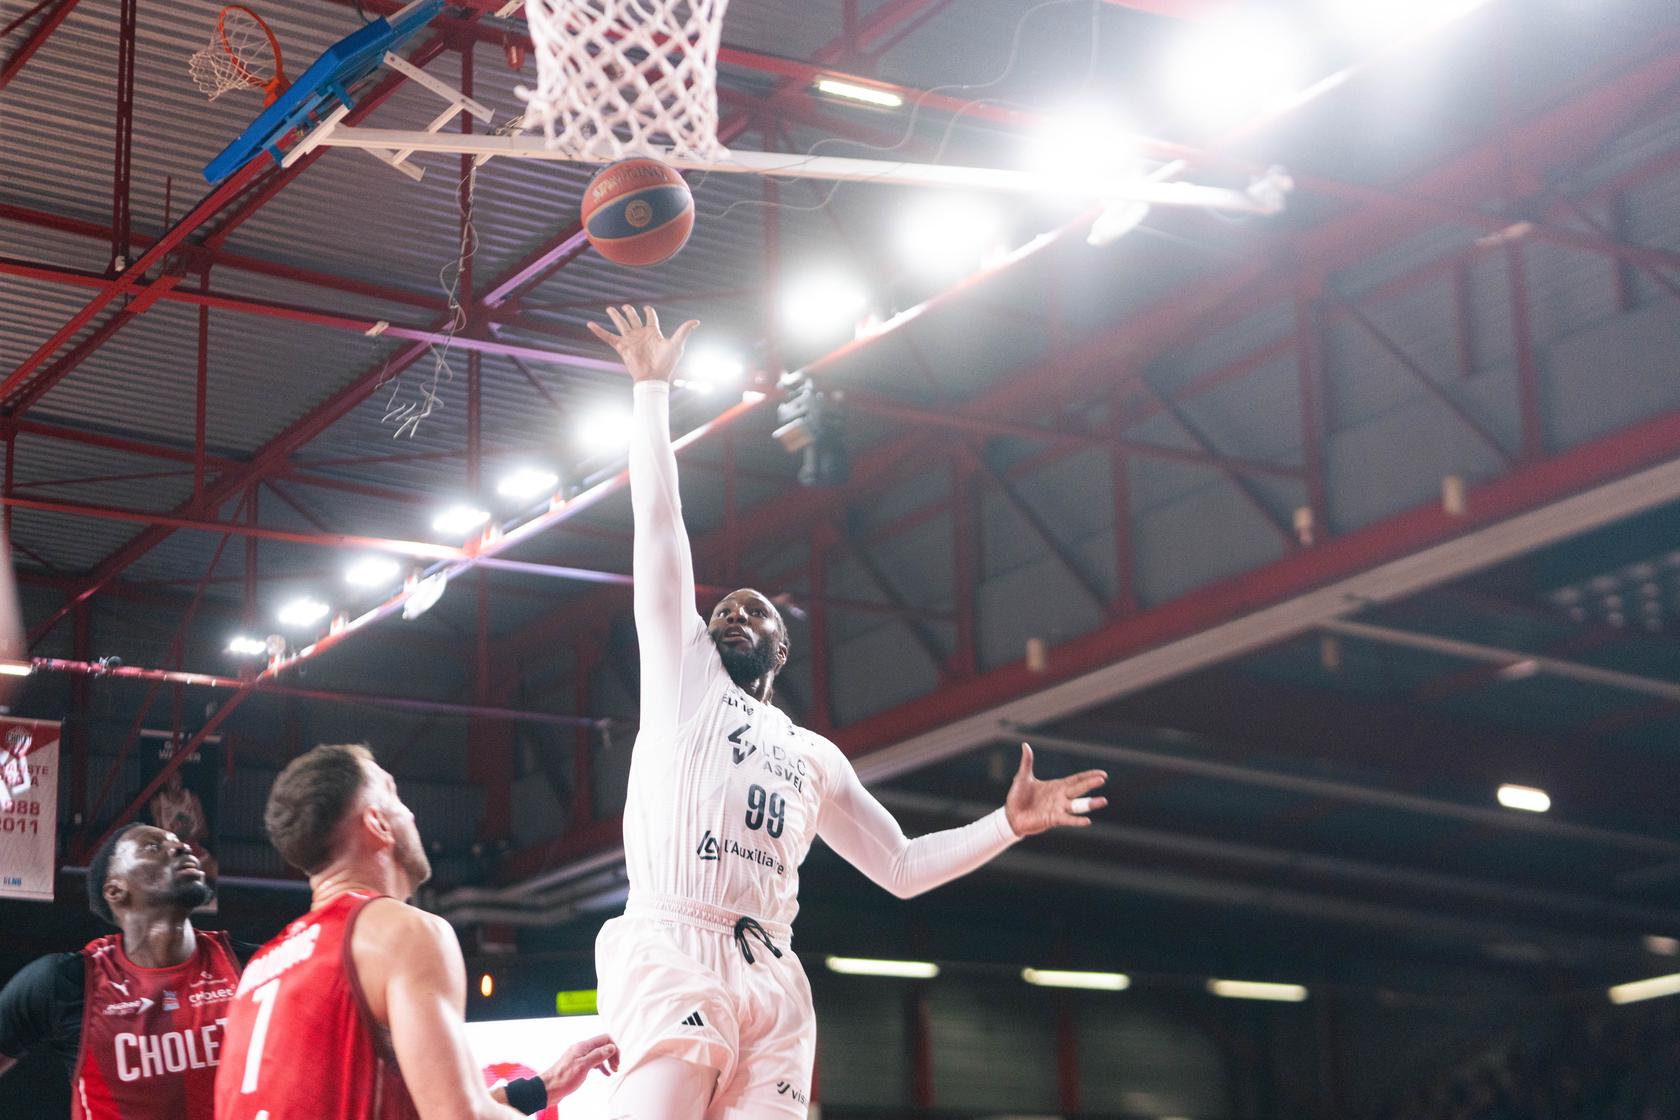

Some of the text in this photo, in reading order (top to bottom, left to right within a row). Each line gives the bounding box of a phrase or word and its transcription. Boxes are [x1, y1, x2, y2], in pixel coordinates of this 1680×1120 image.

[763, 760, 803, 794] ASVEL
[3, 799, 40, 816] 988
[745, 783, 785, 839] 99
[0, 817, 38, 834] 011
[240, 977, 280, 1094] 1
[791, 1089, 808, 1105] vis
